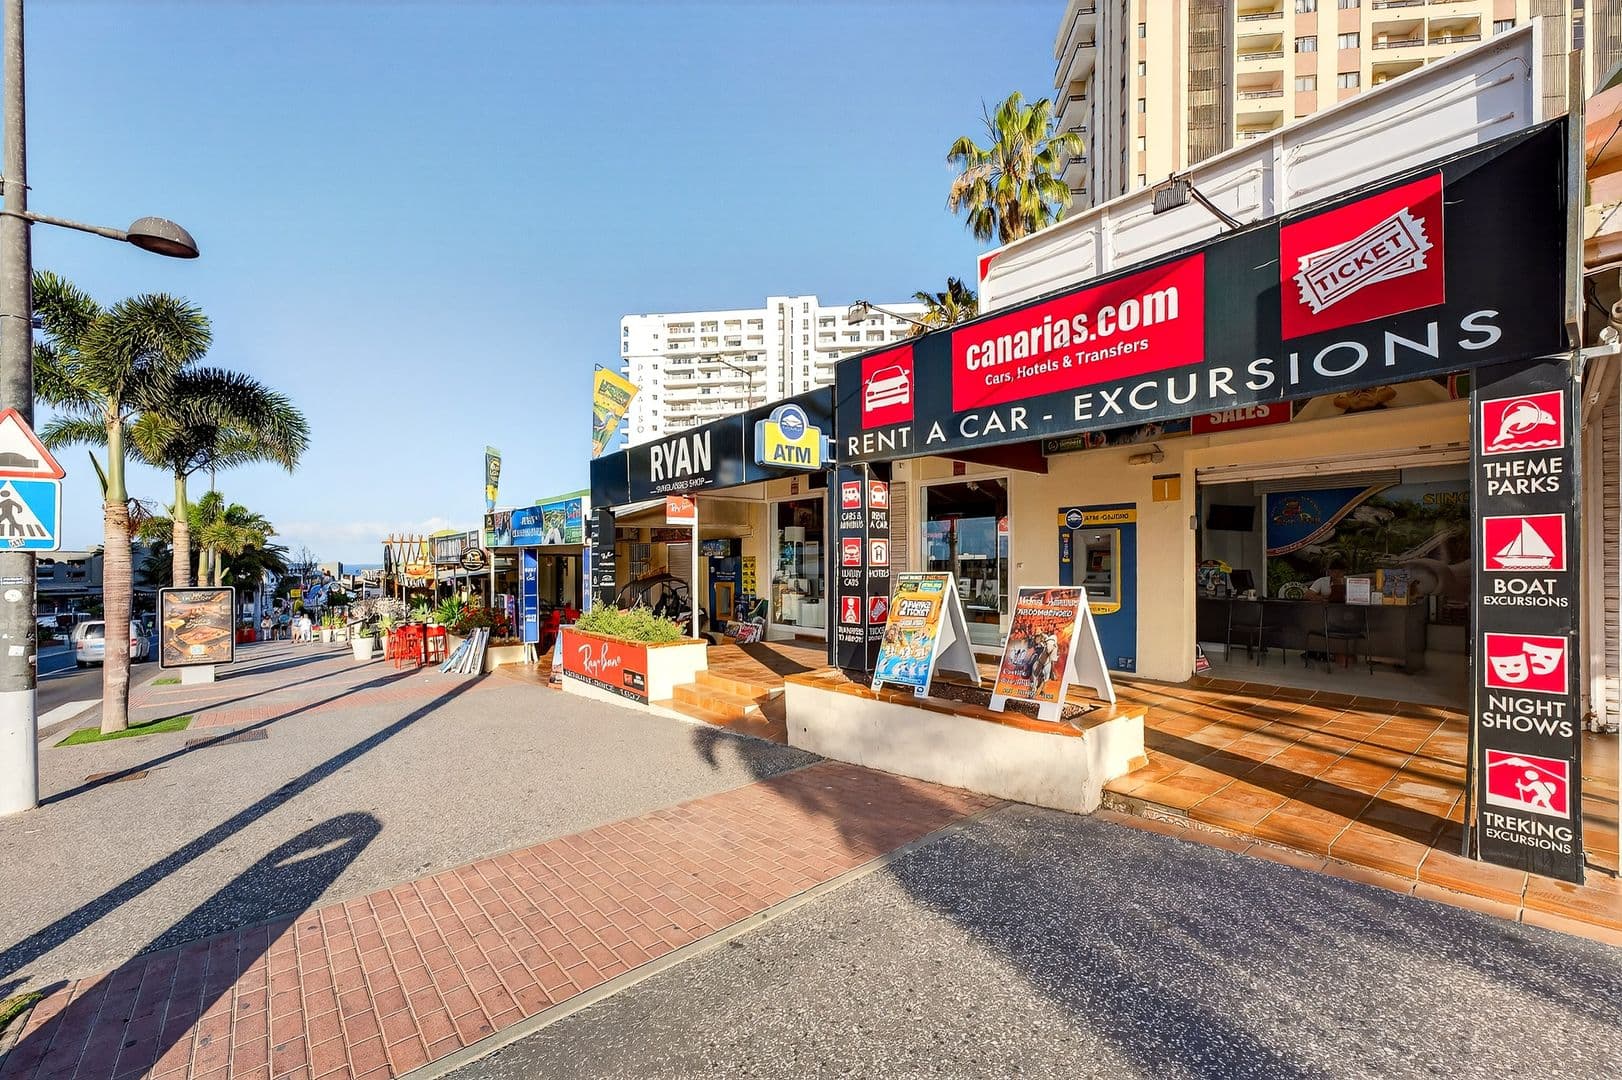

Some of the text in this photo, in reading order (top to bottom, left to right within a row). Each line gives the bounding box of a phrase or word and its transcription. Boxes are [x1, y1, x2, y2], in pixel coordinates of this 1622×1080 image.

[1314, 231, 1404, 292] TICKET
[966, 286, 1180, 371] canarias.com
[985, 338, 1149, 386] Cars, Hotels & Transfers
[848, 427, 912, 456] RENT
[926, 421, 947, 445] A
[960, 407, 1029, 438] CAR
[1074, 310, 1502, 421] EXCURSIONS
[651, 430, 711, 482] RYAN
[774, 444, 811, 464] ATM
[1482, 457, 1563, 479] THEME
[1487, 475, 1560, 496] PARKS
[1494, 578, 1557, 596] BOAT
[1483, 595, 1569, 608] EXCURSIONS
[1488, 694, 1567, 718] NIGHT
[1482, 711, 1573, 738] SHOWS
[1483, 811, 1573, 843] TREKING
[1486, 828, 1572, 855] EXCURSIONS
